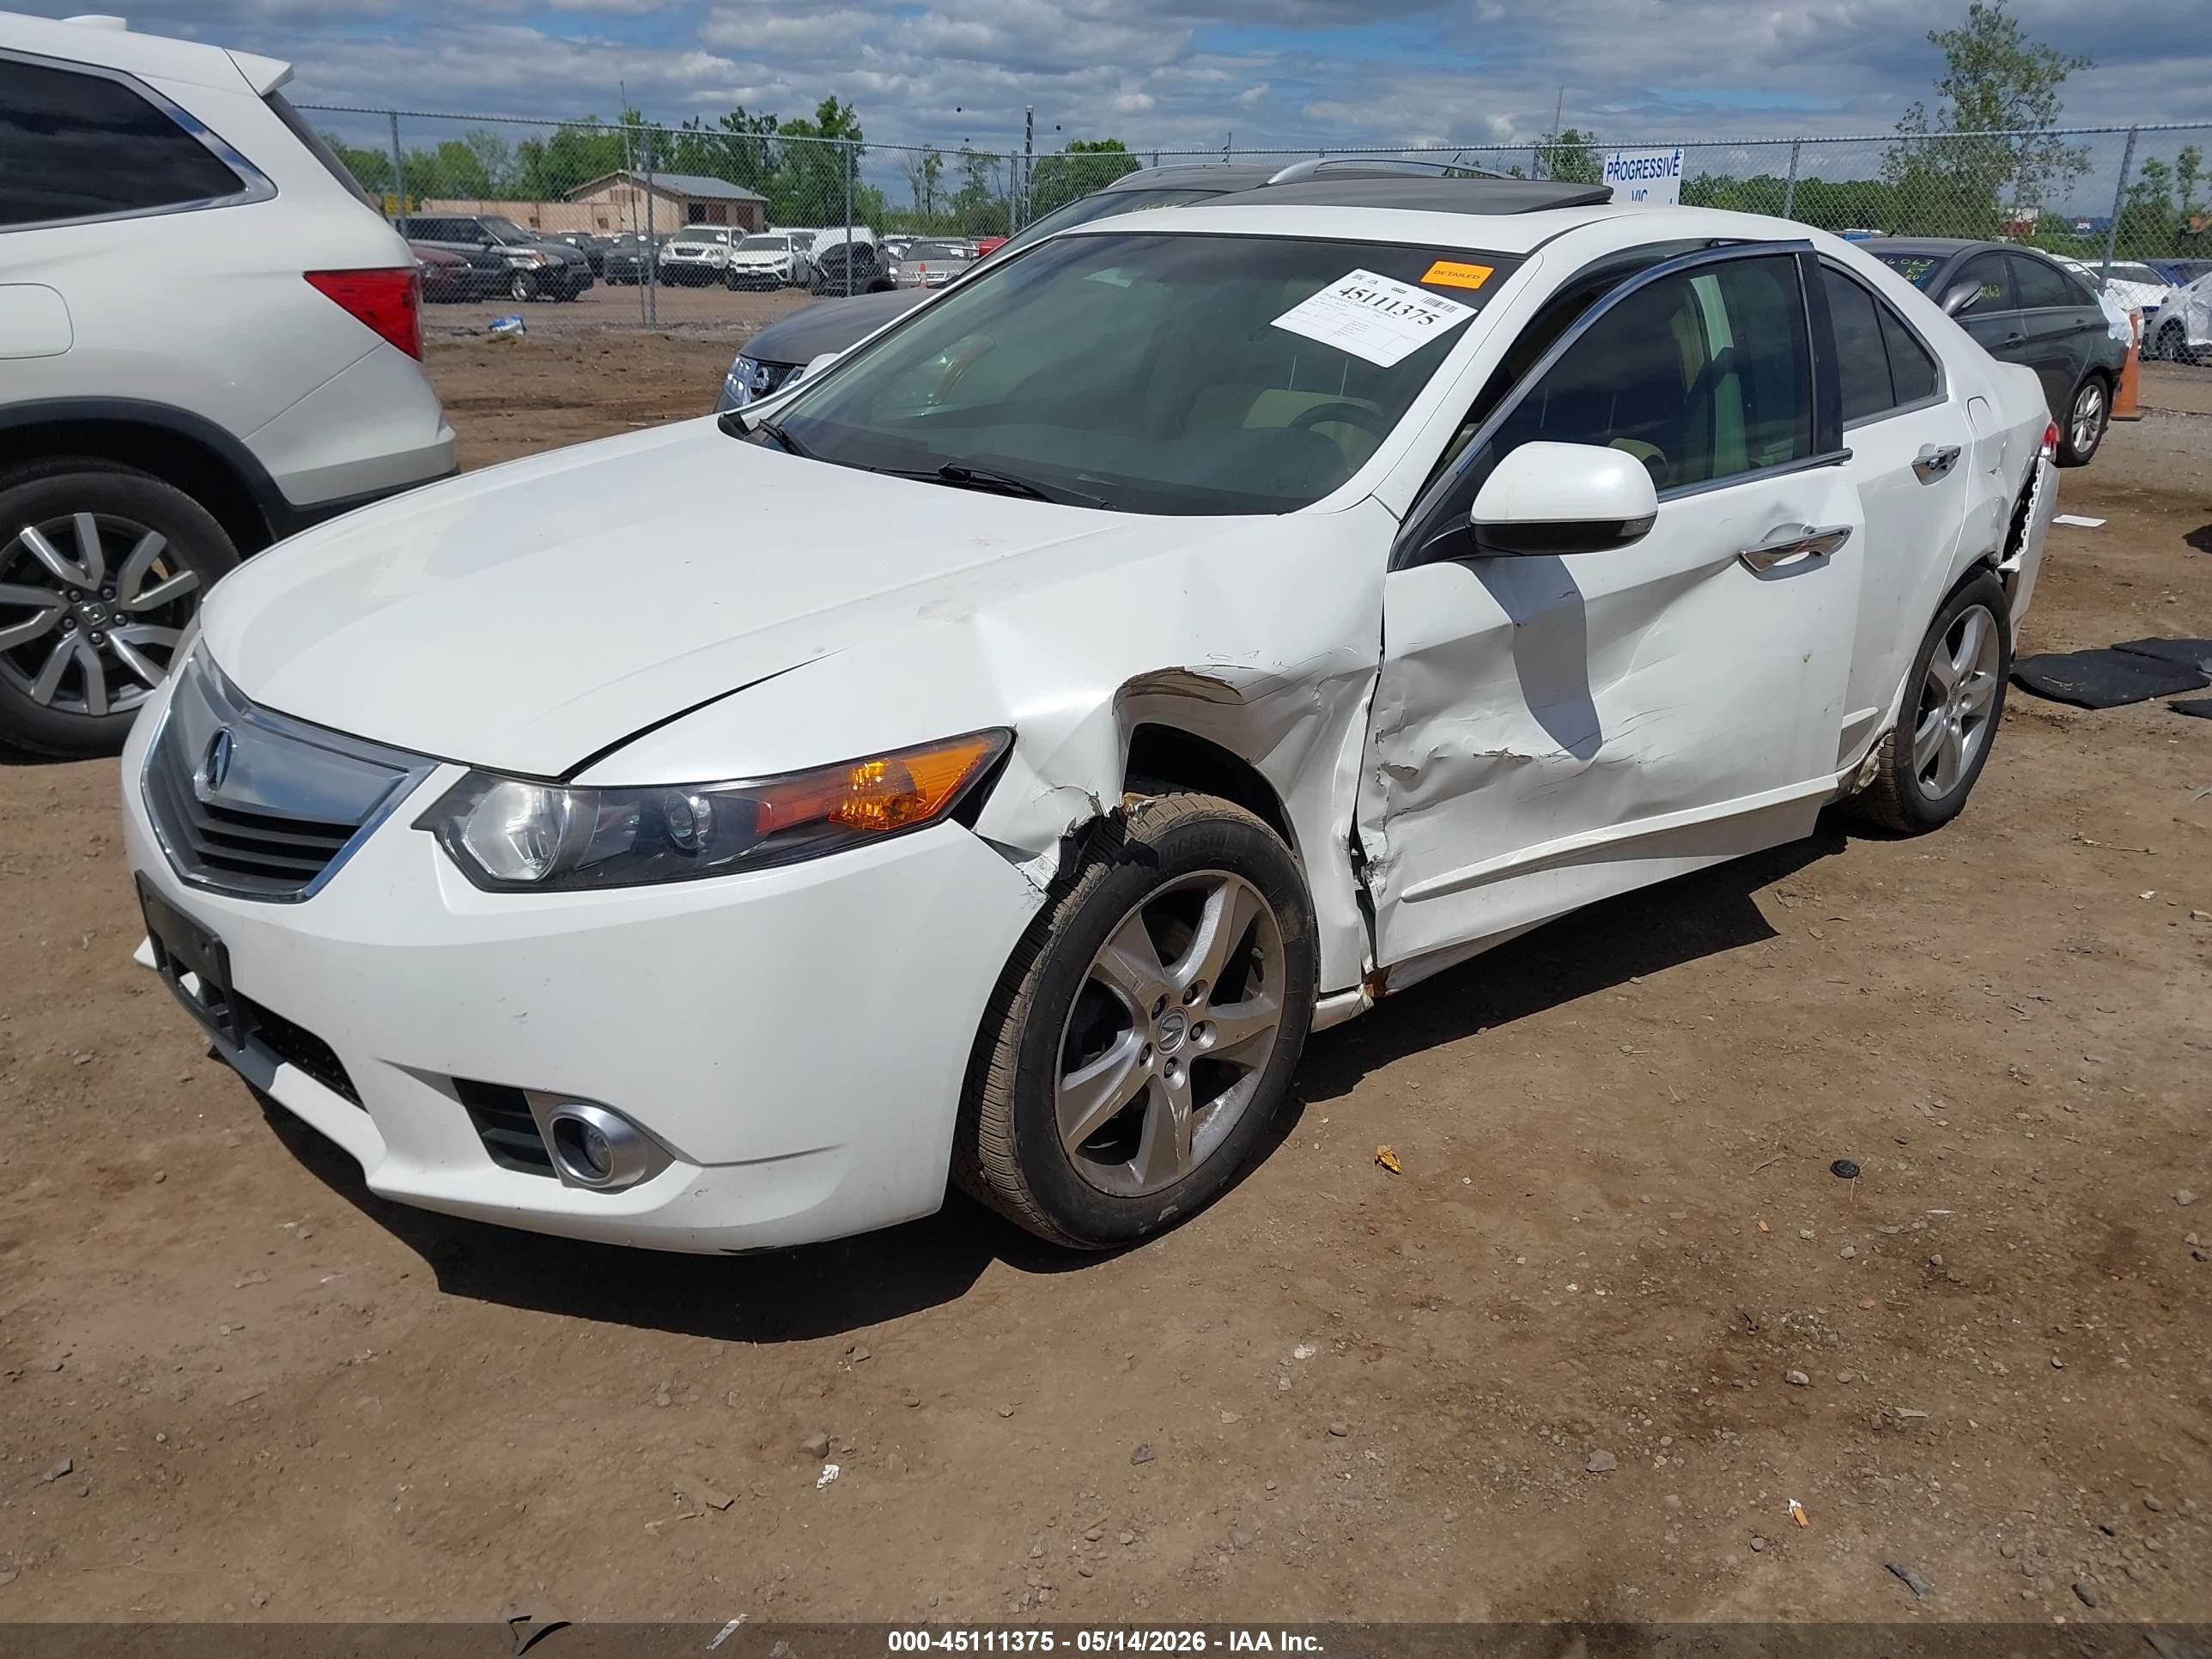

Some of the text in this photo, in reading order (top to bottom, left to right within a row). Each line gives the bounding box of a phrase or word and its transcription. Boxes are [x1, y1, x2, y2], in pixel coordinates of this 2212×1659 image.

[1607, 156, 1680, 182] PROGRESSIVE
[1433, 270, 1480, 280] DETAILED
[1340, 286, 1441, 325] 45111375
